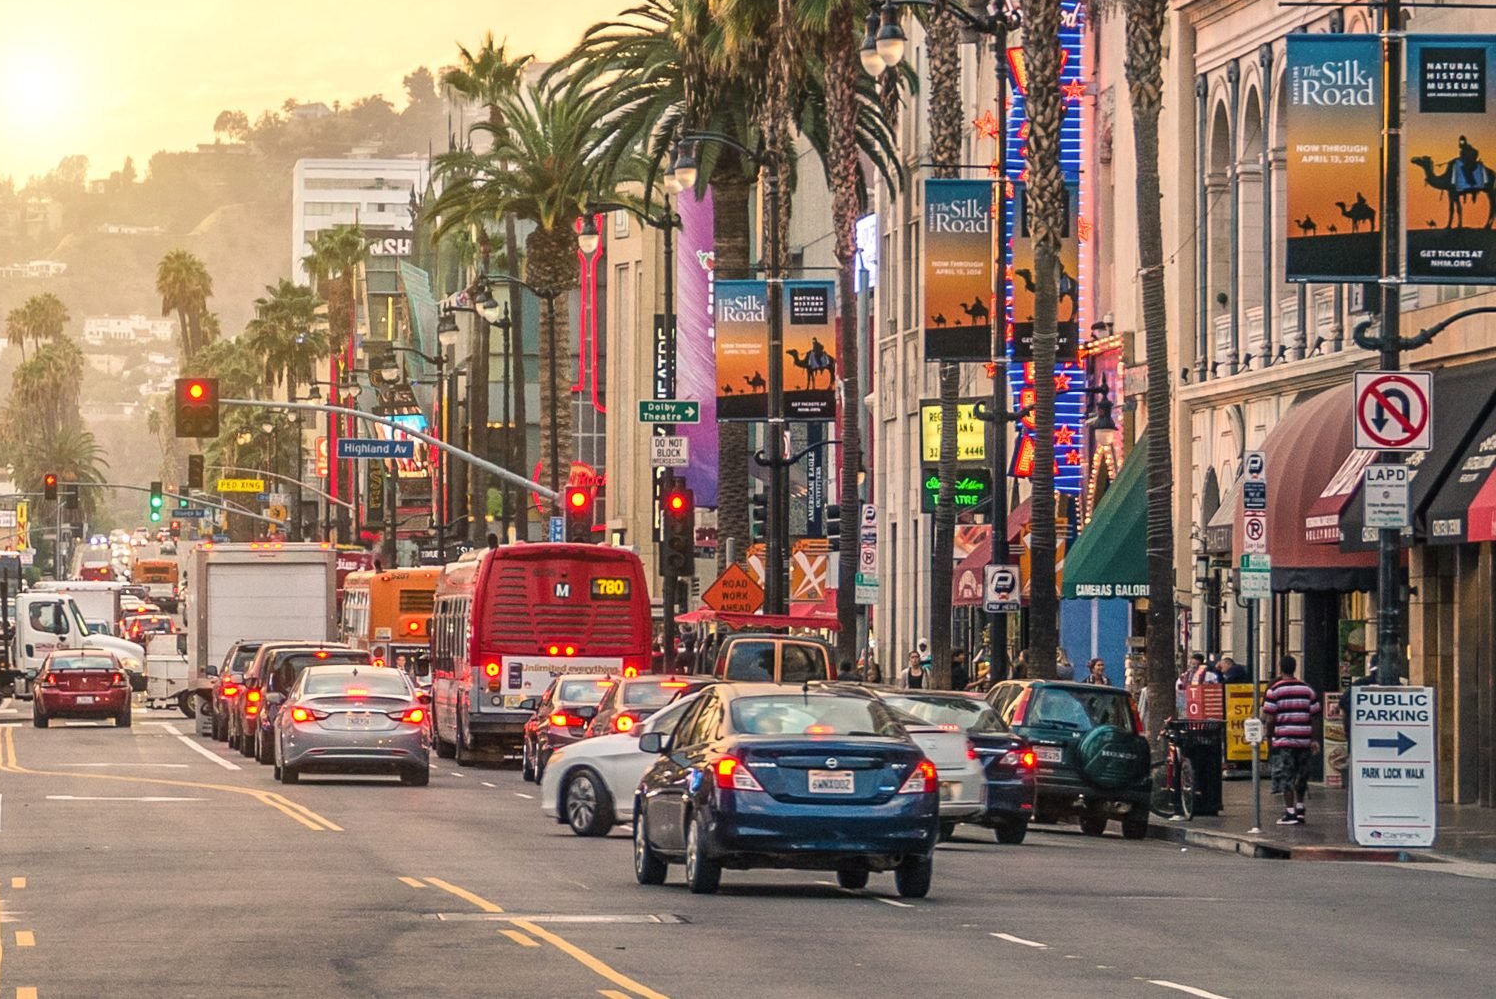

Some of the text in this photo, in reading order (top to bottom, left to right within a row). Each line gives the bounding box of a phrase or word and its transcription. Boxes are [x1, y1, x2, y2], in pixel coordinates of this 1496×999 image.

[1302, 59, 1368, 86] The Silk
[1426, 62, 1479, 71] NATURAL
[1426, 72, 1479, 80] HISTORY
[1302, 77, 1375, 106] Road
[1426, 82, 1479, 90] MUSEUM
[1296, 144, 1369, 153] NOW THROUGH
[1301, 155, 1328, 163] APRIL
[1343, 155, 1365, 163] 2014
[950, 199, 983, 219] Silk
[936, 212, 989, 233] Road
[1438, 250, 1470, 258] TICKETS
[1471, 250, 1483, 258] AT
[735, 295, 761, 310] Silk
[724, 305, 766, 322] Road
[648, 403, 676, 413] Dolby
[643, 412, 682, 421] Theatre
[654, 438, 683, 448] DO NOT
[344, 443, 407, 456] Highland Av
[656, 448, 681, 458] BLOCK
[1367, 469, 1406, 481] LAPD
[597, 579, 624, 595] 780
[722, 580, 748, 588] ROAD
[1076, 584, 1150, 596] CAMERAS GALOR
[556, 584, 570, 597] M
[722, 592, 748, 600] WORK
[720, 604, 751, 612] AHEAD
[1356, 693, 1427, 707] PUBLIC
[1355, 709, 1429, 722] PARKING
[1361, 767, 1425, 779] PARK LOCK WALK
